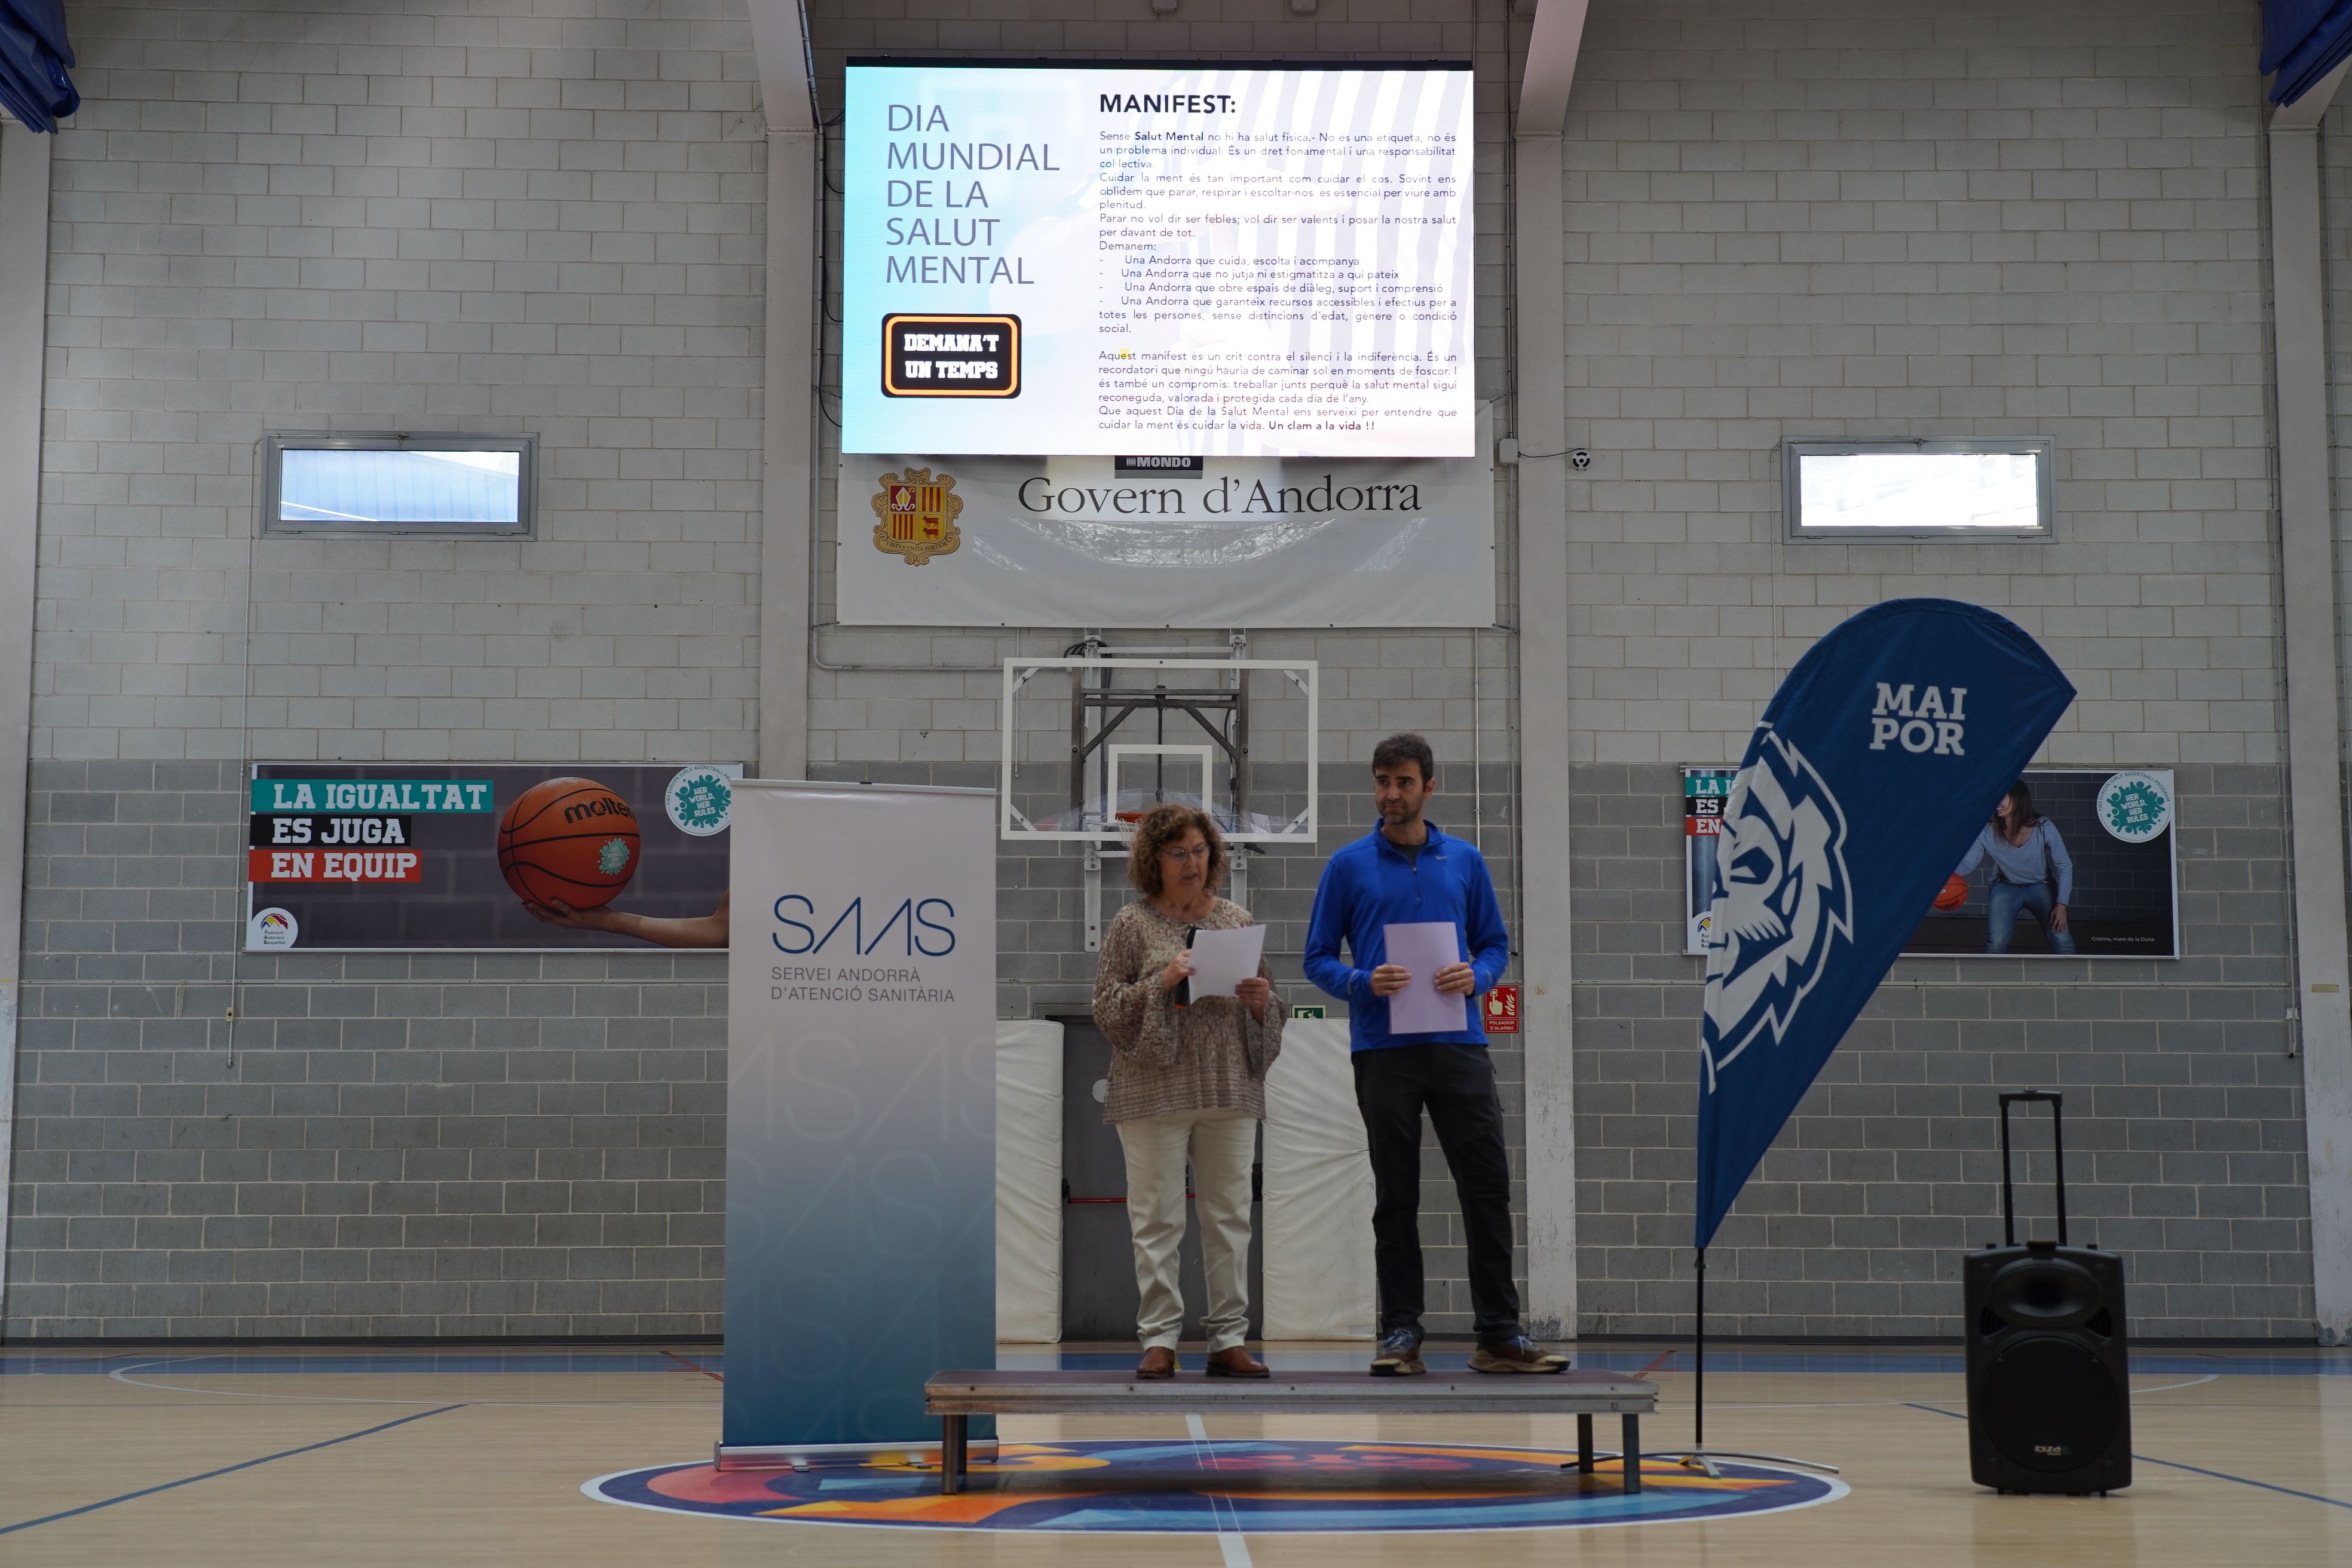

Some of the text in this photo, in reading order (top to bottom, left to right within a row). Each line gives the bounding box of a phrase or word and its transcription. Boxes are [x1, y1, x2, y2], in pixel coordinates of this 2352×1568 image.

[1100, 94, 1236, 114] MANIFEST:
[889, 105, 950, 131] DIA
[1100, 131, 1131, 140] Sense
[1134, 131, 1162, 140] Salut
[1166, 131, 1203, 141] Mental
[1225, 131, 1233, 141] hi
[1238, 131, 1250, 141] ha
[1254, 131, 1279, 141] salut
[1319, 132, 1335, 142] No
[1339, 132, 1350, 142] és
[1376, 133, 1423, 145] etiqueta,
[1444, 133, 1456, 142] és
[887, 142, 1060, 171] MUNDIAL
[887, 180, 989, 208] DE LA
[1100, 200, 1146, 212] plenitud.
[886, 217, 1000, 246] SALUT
[1100, 227, 1195, 239] per davant de tot.
[1100, 241, 1156, 250] Demanem:
[1125, 255, 1146, 264] Una
[1149, 255, 1192, 265] Andorra
[1195, 258, 1215, 267] que
[1218, 255, 1249, 267] cuida,
[1252, 255, 1290, 265] escolta
[1299, 259, 1359, 268] acompanya
[886, 256, 1034, 284] MENTAL
[1121, 268, 1142, 278] Una
[1145, 268, 1189, 278] Andorra
[1192, 271, 1212, 280] que
[1232, 269, 1254, 281] jutja
[1257, 269, 1267, 278] ni
[1270, 269, 1335, 281] estigmatitza
[1347, 270, 1364, 281] qui
[1367, 270, 1399, 281] pateix
[1125, 282, 1145, 292] Una
[1149, 282, 1192, 292] Andorra
[1195, 285, 1215, 294] que
[1218, 283, 1243, 292] obre
[1247, 283, 1279, 295] espais
[1283, 283, 1296, 292] de
[1299, 283, 1334, 295] diàleg,
[1338, 283, 1372, 295] suport
[1382, 283, 1443, 295] comprensió
[1121, 296, 1142, 305] Una
[1145, 296, 1189, 305] Andorra
[1193, 299, 1212, 308] que
[1216, 296, 1266, 308] garanteix
[1316, 297, 1375, 307] accessibles
[1385, 297, 1426, 307] efectius
[1429, 300, 1447, 309] per
[1098, 310, 1126, 319] totes
[1134, 310, 1147, 319] les
[1154, 313, 1205, 321] persones,
[1248, 310, 1304, 320] distincions
[1311, 310, 1348, 322] d'edat,
[1355, 311, 1392, 323] gènere
[1413, 311, 1457, 320] condició
[1099, 323, 1131, 333] social.
[904, 333, 999, 352] DEMANA'T
[905, 360, 998, 379] UN TEMPS
[1098, 392, 1164, 404] reconeguda,
[1168, 393, 1214, 402] valorada
[1223, 393, 1275, 405] protegida
[1278, 393, 1303, 403] cada
[1307, 393, 1322, 403] dia
[1326, 393, 1339, 403] de
[1343, 393, 1369, 405] l'any.
[1098, 419, 1131, 429] cuidar
[1135, 419, 1143, 429] la
[1147, 419, 1174, 429] ment
[1177, 419, 1189, 429] és
[1192, 419, 1224, 429] cuidar
[1228, 420, 1236, 430] la
[1239, 420, 1264, 430] vida.
[1269, 420, 1284, 430] Un
[1287, 420, 1312, 430] clam
[1325, 420, 1335, 430] la
[1339, 421, 1361, 430] vida
[1137, 457, 1192, 467] MONDO
[1018, 474, 1422, 514] Govern d'Andorra
[1872, 682, 1967, 721] MAI
[1869, 717, 1965, 755] POR
[694, 765, 723, 776] BASKETBALL
[694, 786, 708, 795] HER
[1695, 779, 1720, 794] LA
[2099, 782, 2111, 800] EUROPE
[2125, 771, 2154, 782] BASKETBALL
[2154, 780, 2170, 803] PROGRAM
[273, 783, 487, 810] LA IGUALTAT
[2126, 793, 2139, 802] HER
[564, 797, 636, 824] molten
[694, 807, 715, 817] RULES
[697, 801, 710, 809] HER
[1696, 799, 1719, 814] ES
[2129, 807, 2143, 816] HER
[2127, 814, 2148, 823] RULES
[272, 818, 405, 844] ES JUGA
[1696, 819, 1721, 833] EN
[271, 852, 417, 881] EN EQUIP
[772, 894, 956, 957] SAAS
[771, 966, 921, 982] SERVEI ANDORRÀ
[771, 985, 956, 1003] D'ATENCIÓ SANITÀRIA
